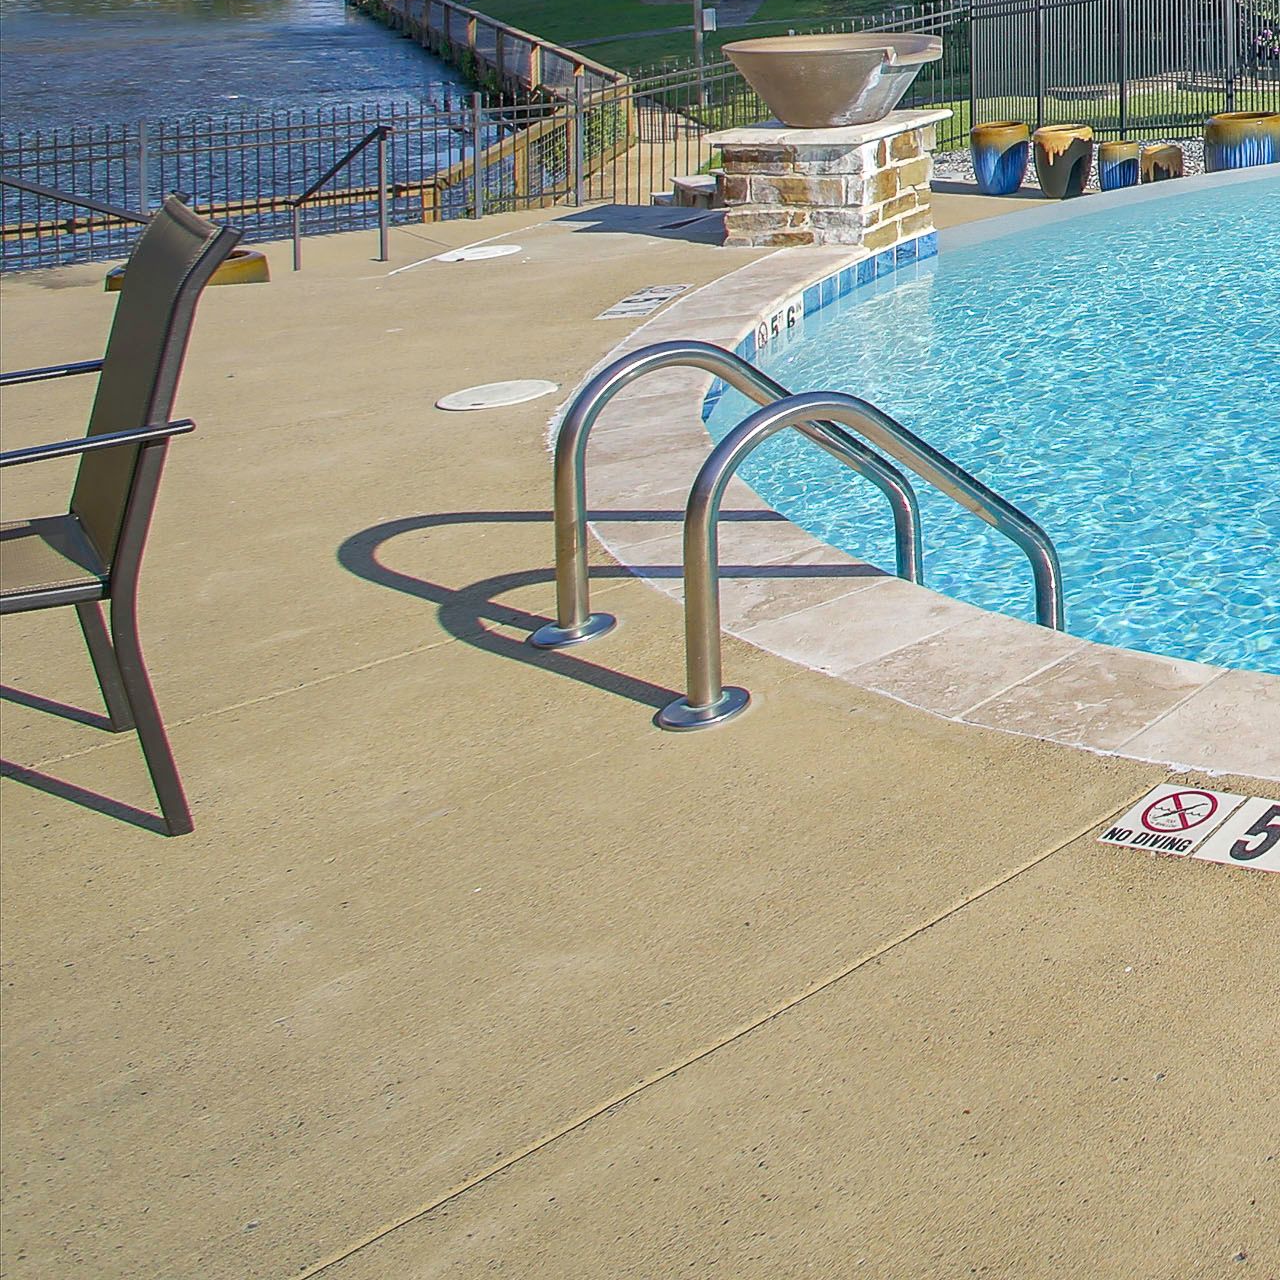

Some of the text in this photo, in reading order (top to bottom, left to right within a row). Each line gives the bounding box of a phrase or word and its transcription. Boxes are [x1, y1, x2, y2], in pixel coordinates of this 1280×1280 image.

[771, 314, 779, 339] 5
[1102, 827, 1193, 853] NO DIVING
